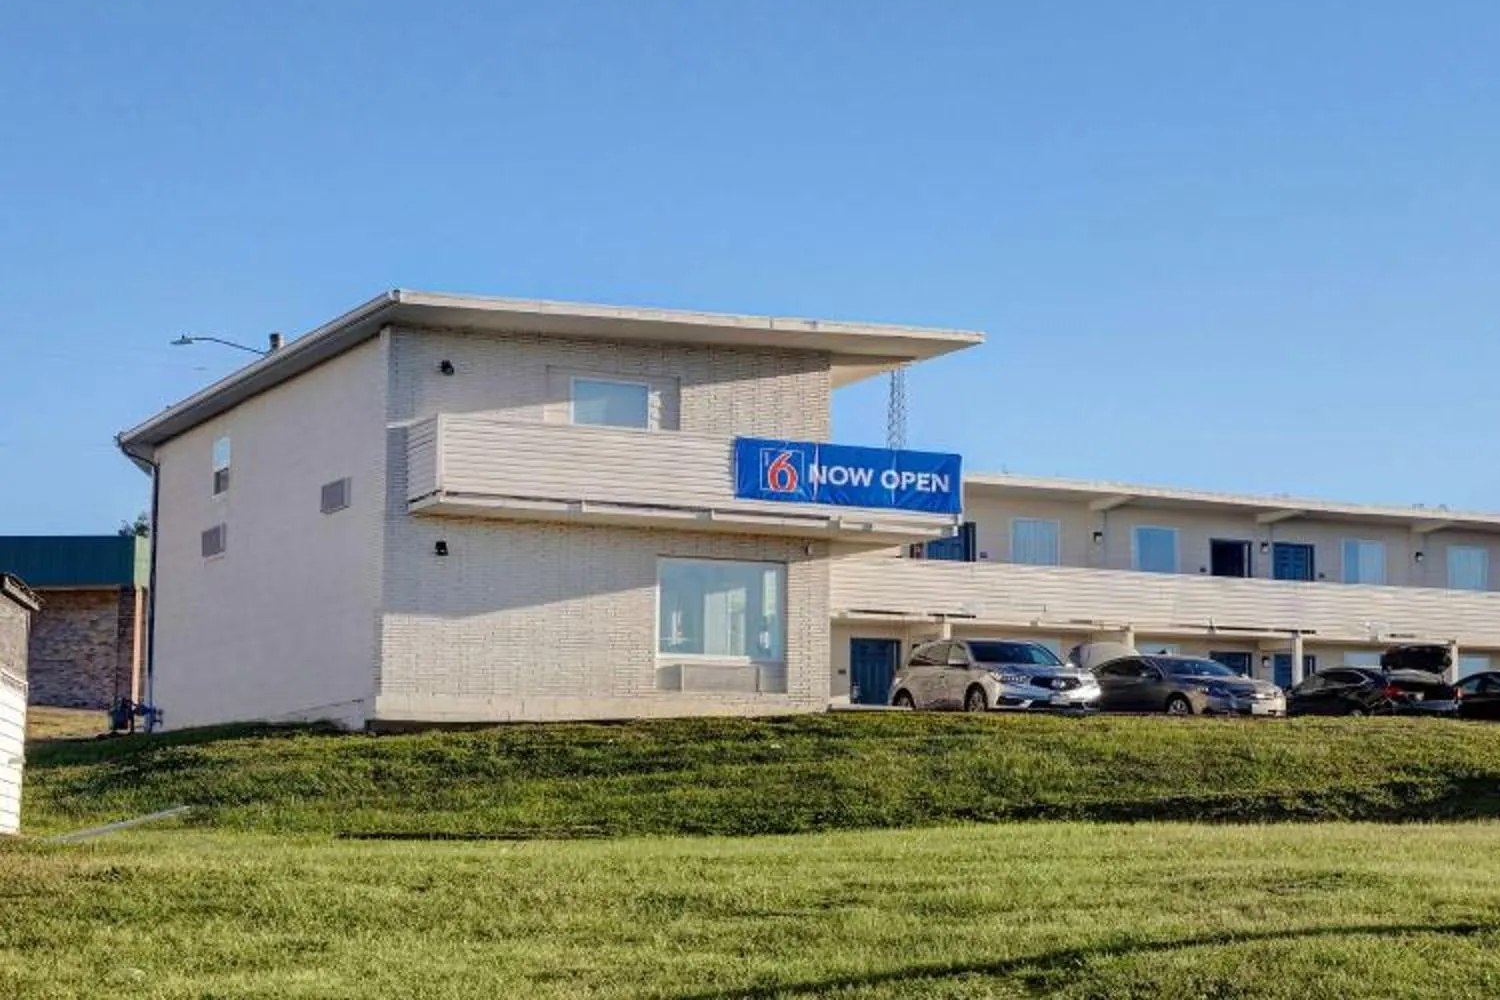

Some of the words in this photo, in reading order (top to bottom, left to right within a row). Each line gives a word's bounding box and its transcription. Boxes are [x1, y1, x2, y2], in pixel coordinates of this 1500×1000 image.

[768, 451, 799, 492] 6
[809, 463, 873, 487] NOW
[880, 469, 949, 493] OPEN
